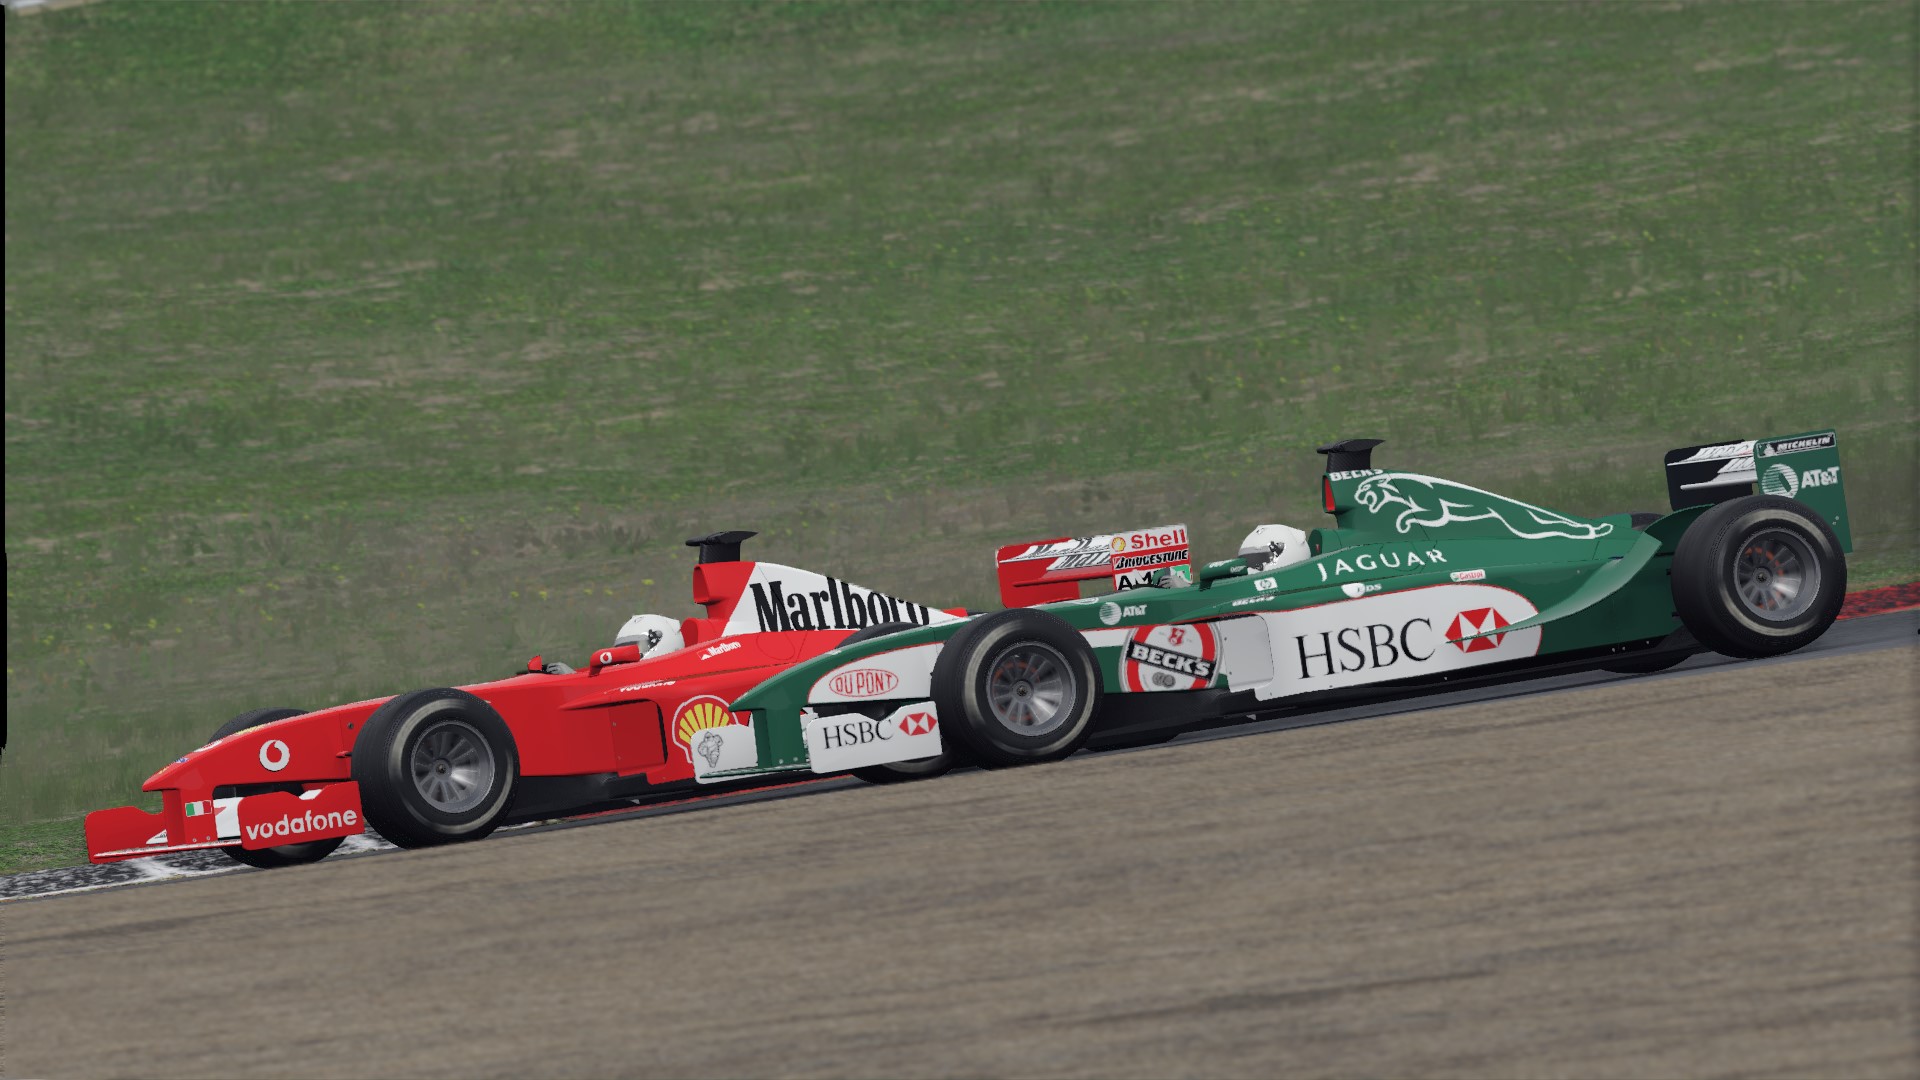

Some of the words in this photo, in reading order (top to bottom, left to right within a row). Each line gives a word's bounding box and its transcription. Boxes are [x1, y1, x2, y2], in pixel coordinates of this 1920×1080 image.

[1777, 437, 1831, 450] MICHELIN
[1801, 466, 1840, 489] AT&T
[1131, 529, 1186, 549] Shell
[1114, 550, 1189, 569] BRIDGESTONE
[1317, 549, 1448, 582] JAGUAR
[1123, 605, 1147, 618] AT&T
[1293, 617, 1436, 680] HSBC
[823, 719, 895, 749] HSBC
[246, 809, 357, 840] vodafone
